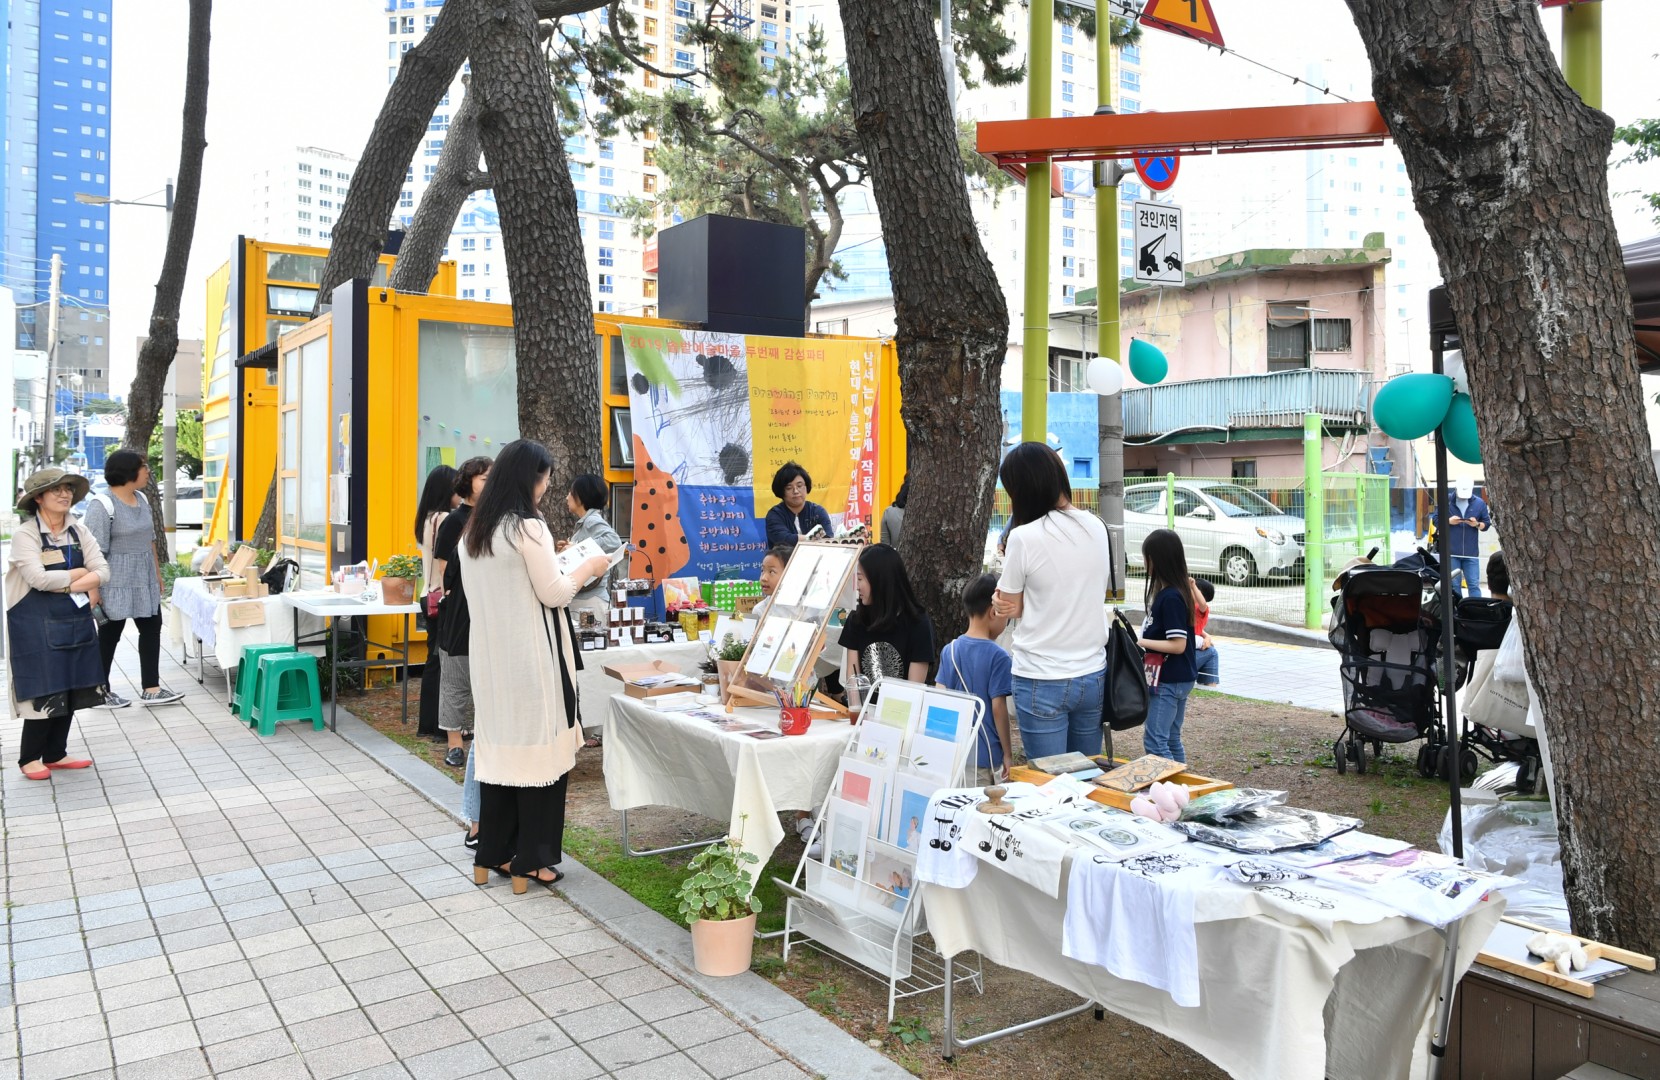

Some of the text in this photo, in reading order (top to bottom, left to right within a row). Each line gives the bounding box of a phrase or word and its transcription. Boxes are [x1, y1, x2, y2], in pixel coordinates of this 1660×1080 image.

[1140, 210, 1178, 232] 견인지역
[629, 336, 662, 350] 2019
[746, 346, 779, 360] 두번째
[784, 348, 825, 361] 감성파티
[752, 387, 838, 401] Drawing Party
[850, 447, 861, 460] 왜
[862, 460, 873, 507] 작품이
[700, 493, 736, 506] 축하공연
[700, 511, 745, 521] 드로잉파티
[699, 527, 741, 537] 공방체험
[699, 542, 767, 553] 핸드메이드마켓
[1010, 838, 1021, 847] Art
[1012, 847, 1024, 858] Fair
